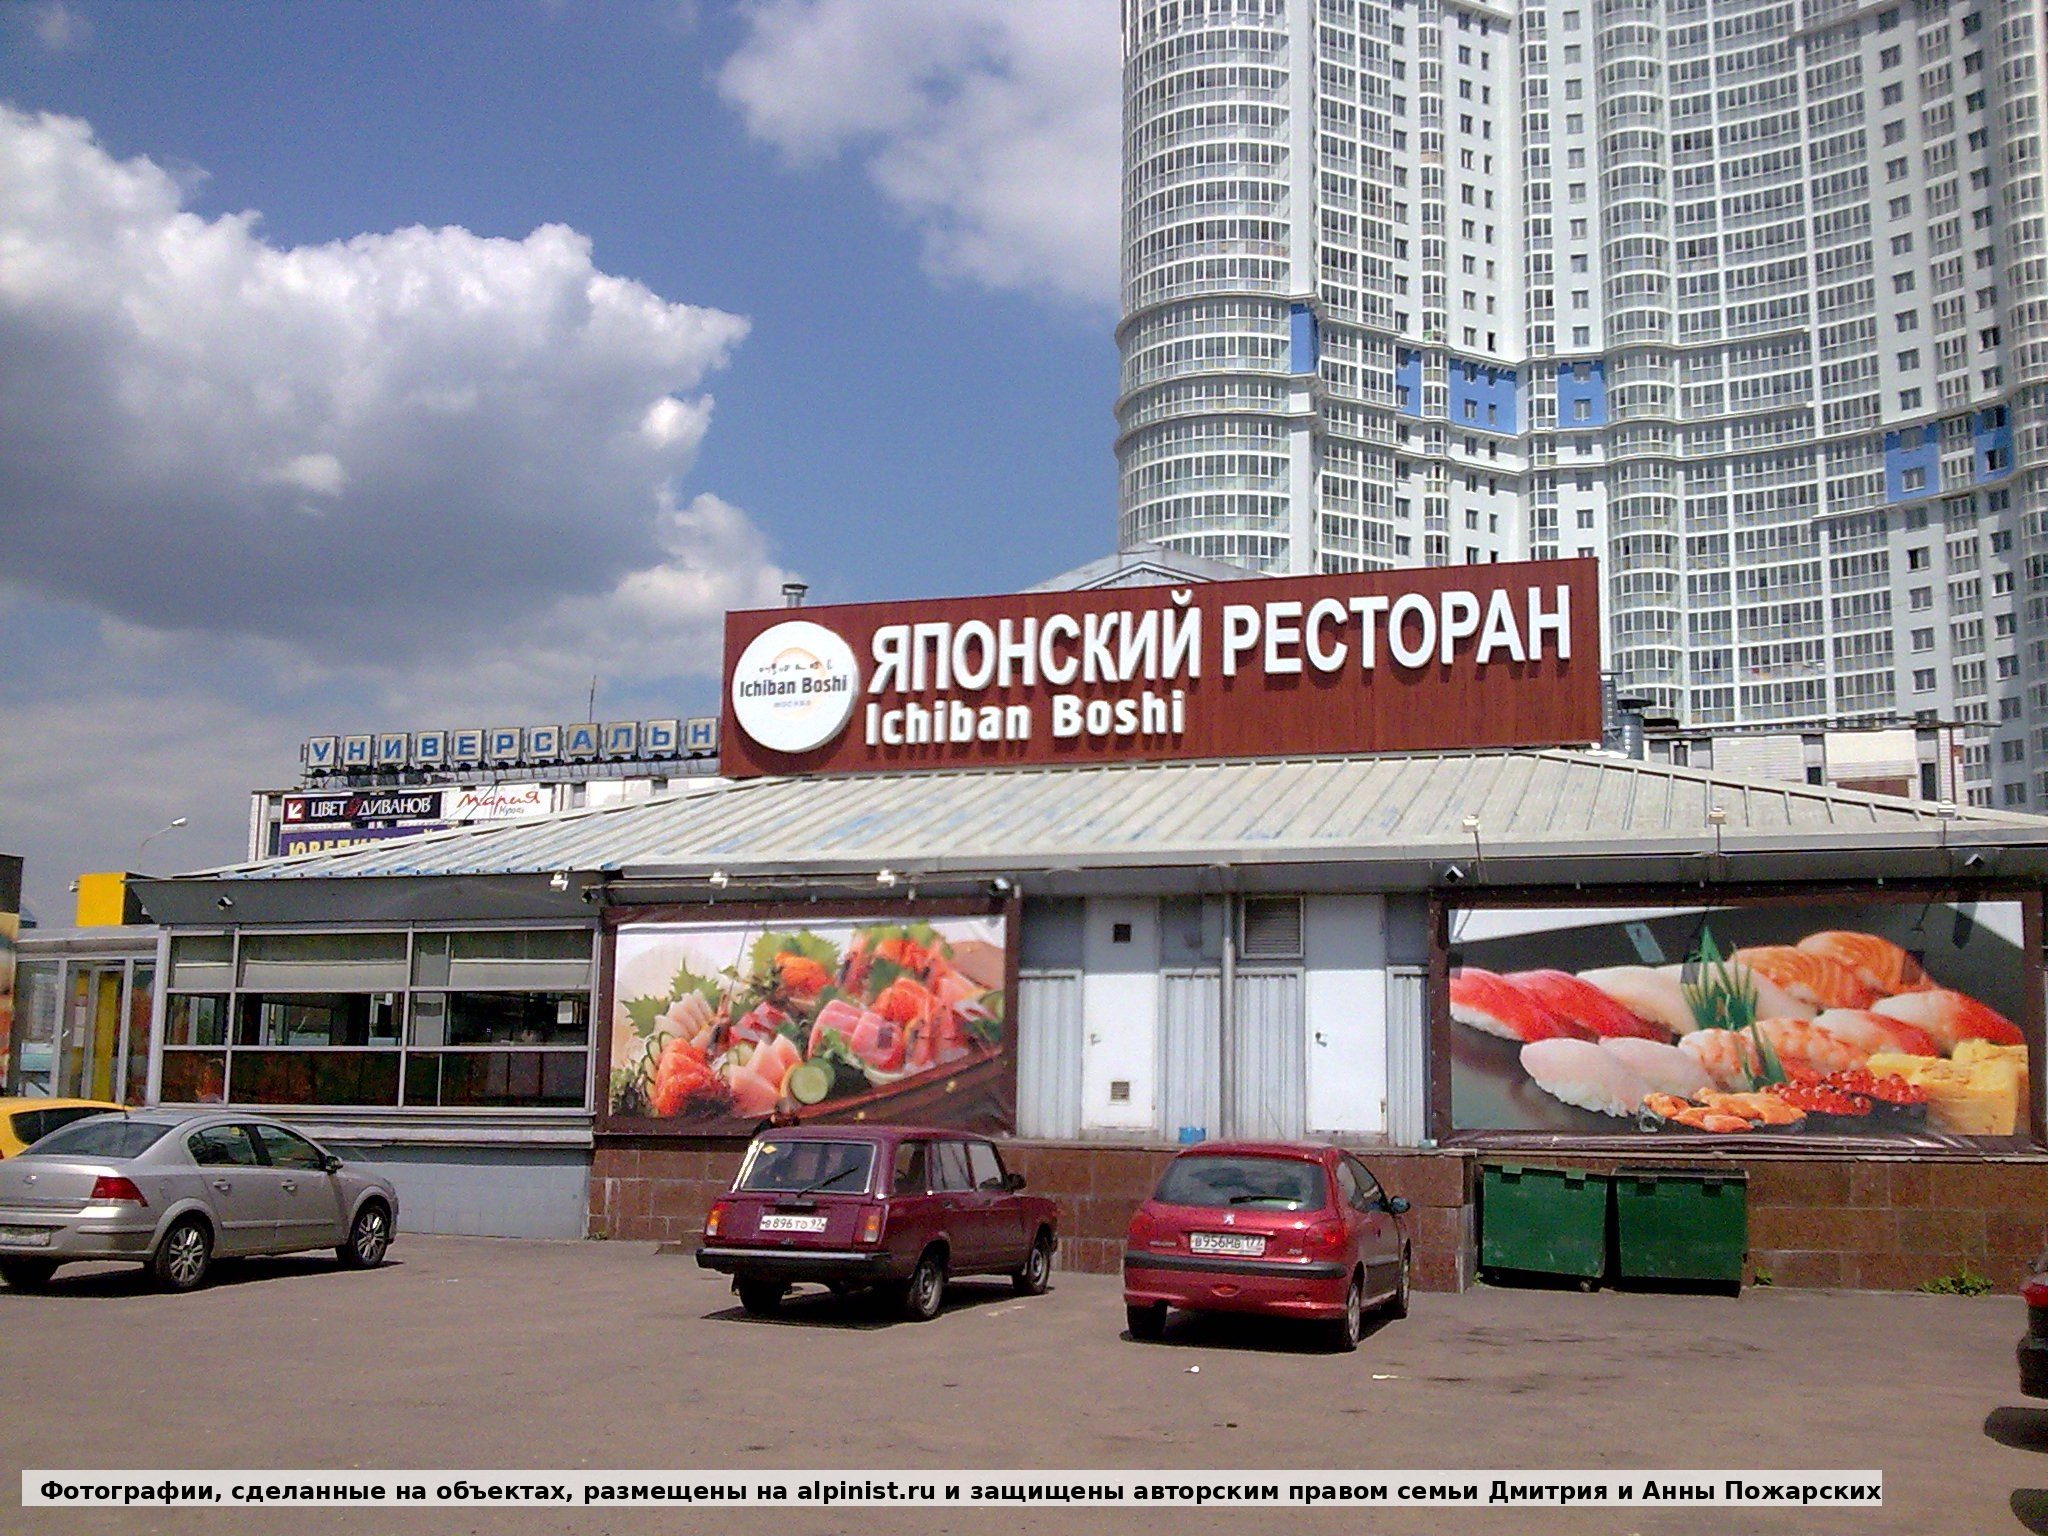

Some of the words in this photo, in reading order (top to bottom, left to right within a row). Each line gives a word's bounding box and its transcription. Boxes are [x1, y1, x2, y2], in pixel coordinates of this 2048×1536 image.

[868, 589, 1202, 694] ЯПОНСКИЙ
[1222, 584, 1571, 677] РЕСТОРАН
[739, 680, 796, 698] Ichiban
[801, 674, 848, 694] Boshi
[865, 700, 1032, 746] Ichiban
[1052, 690, 1185, 739] Boshi
[310, 800, 348, 818] ЦВЕТ
[357, 797, 431, 817] ДИВАНОВ
